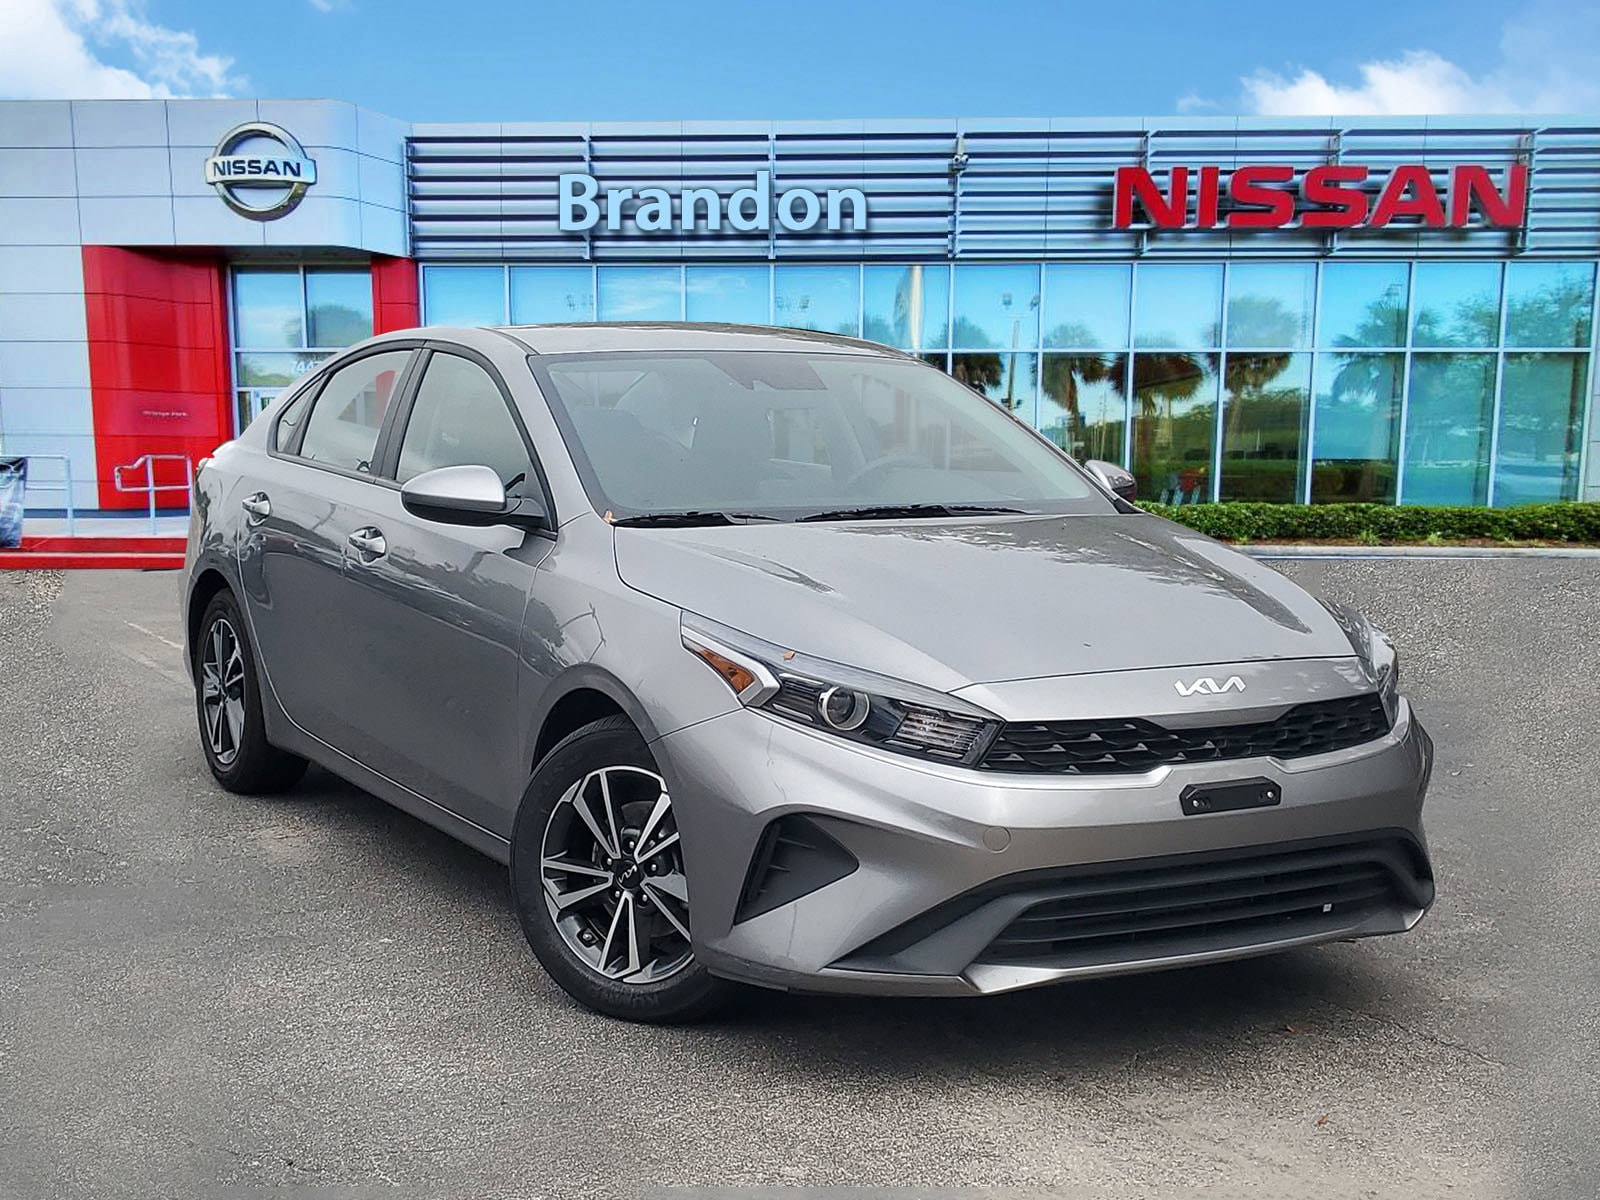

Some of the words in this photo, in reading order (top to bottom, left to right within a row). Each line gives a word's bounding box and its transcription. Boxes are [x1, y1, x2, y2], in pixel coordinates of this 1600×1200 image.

[212, 159, 301, 178] NISSAN
[558, 171, 867, 231] Brandon
[1113, 165, 1527, 228] NISSAN
[1174, 676, 1246, 697] KIA
